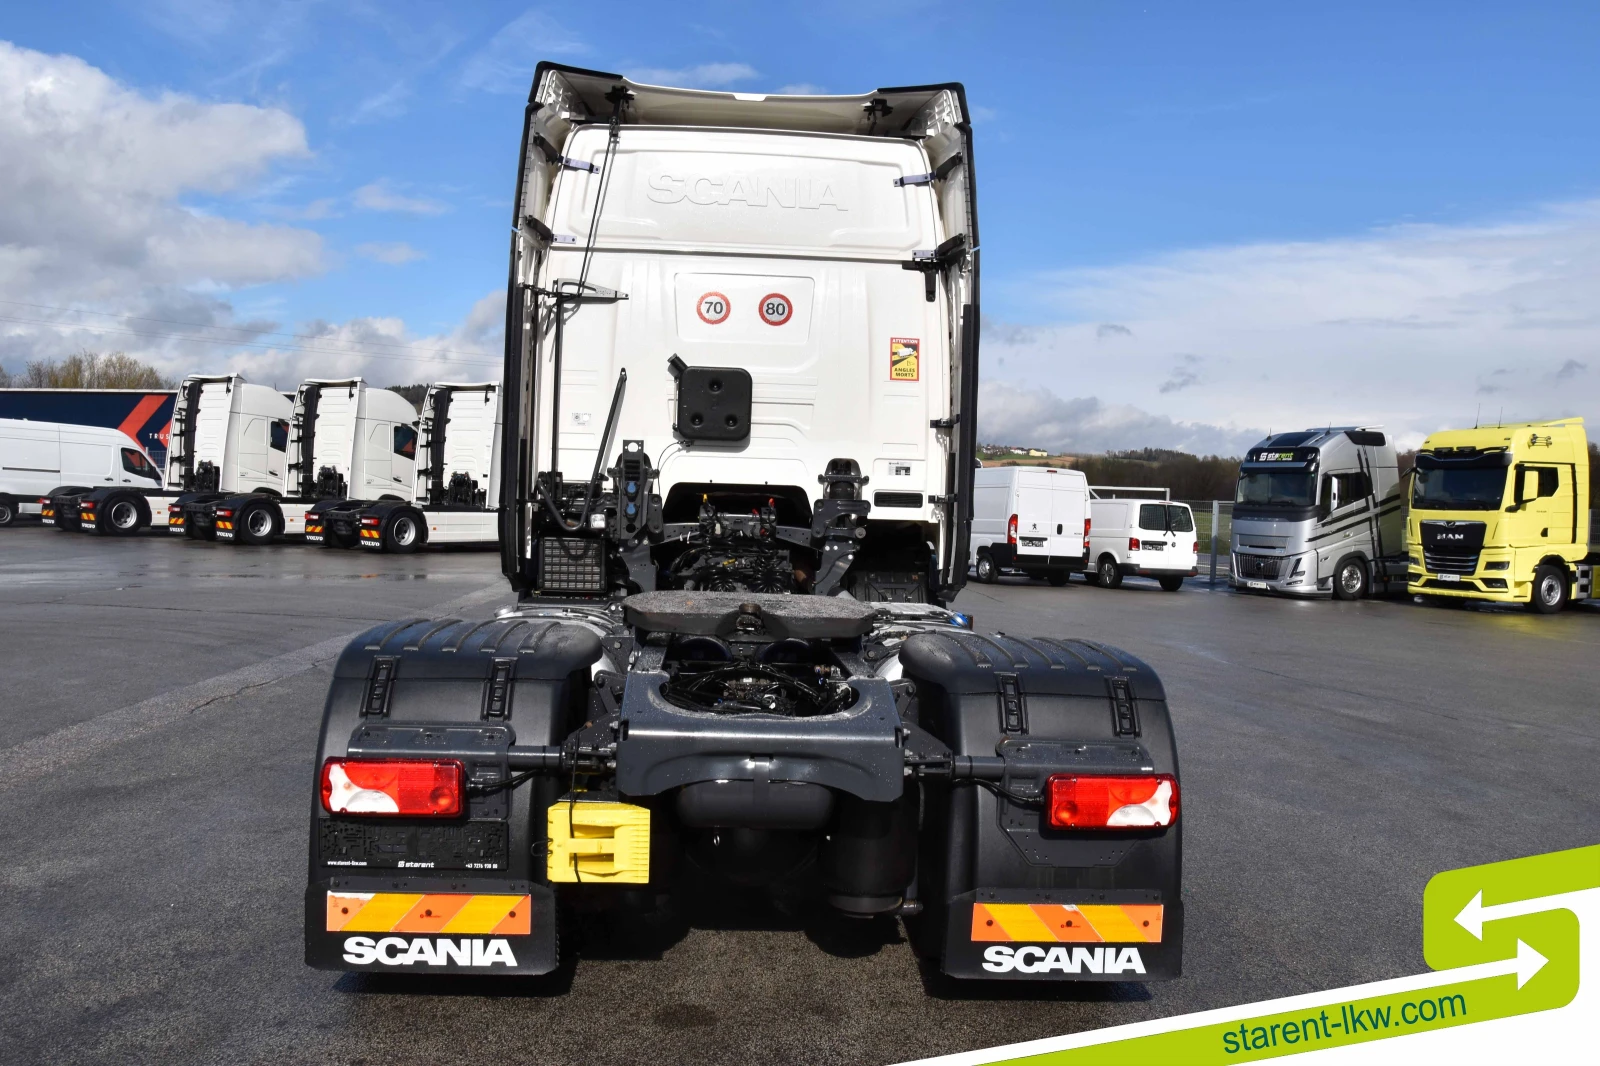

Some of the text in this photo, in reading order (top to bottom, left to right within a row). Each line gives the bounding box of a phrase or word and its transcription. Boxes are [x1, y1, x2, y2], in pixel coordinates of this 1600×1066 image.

[647, 173, 849, 212] SCANIA
[704, 301, 724, 315] 70
[765, 302, 786, 316] 80
[360, 539, 380, 547] VOLVO
[342, 936, 518, 967] SCANIA
[981, 945, 1147, 974] SCANIA
